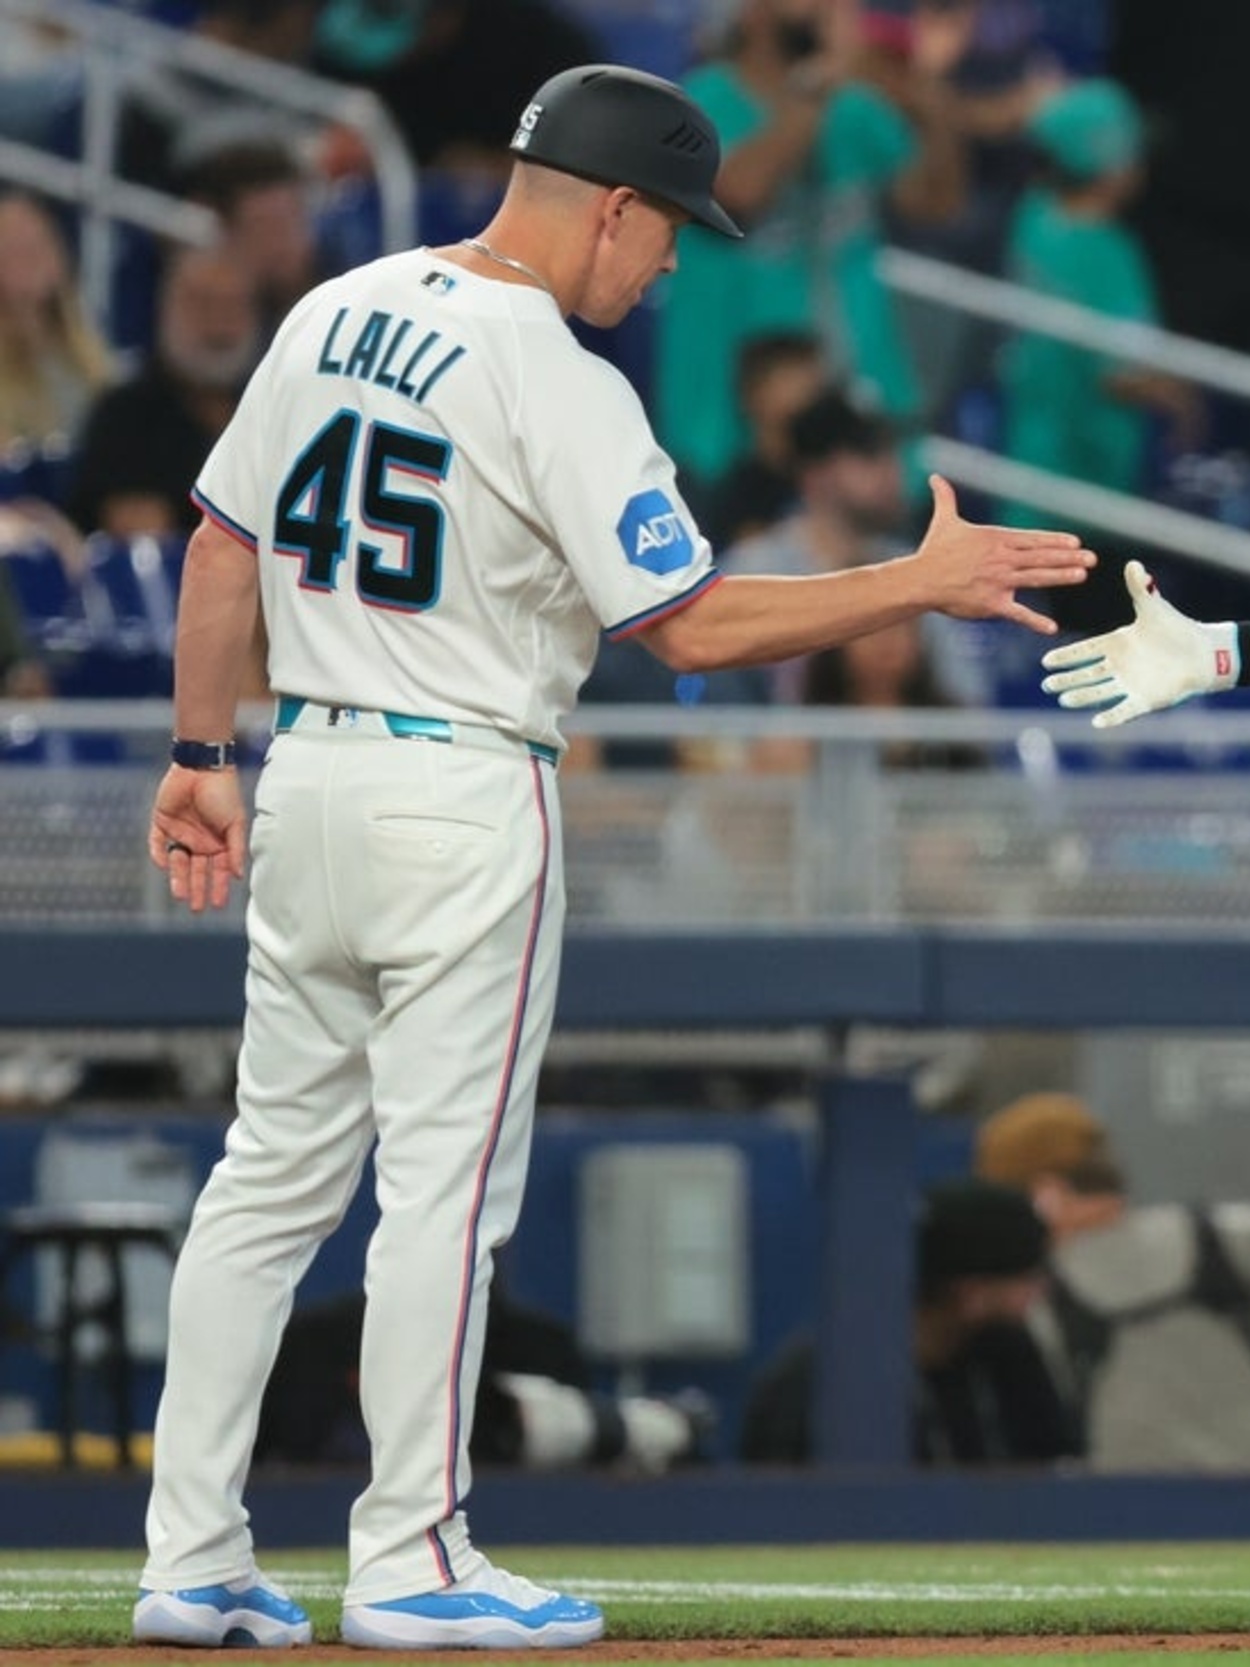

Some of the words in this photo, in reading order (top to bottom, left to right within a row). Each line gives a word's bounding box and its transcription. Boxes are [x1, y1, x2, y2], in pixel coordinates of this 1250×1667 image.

[317, 308, 467, 403] LALLI
[272, 407, 453, 613] 45
[636, 512, 683, 556] ADT
